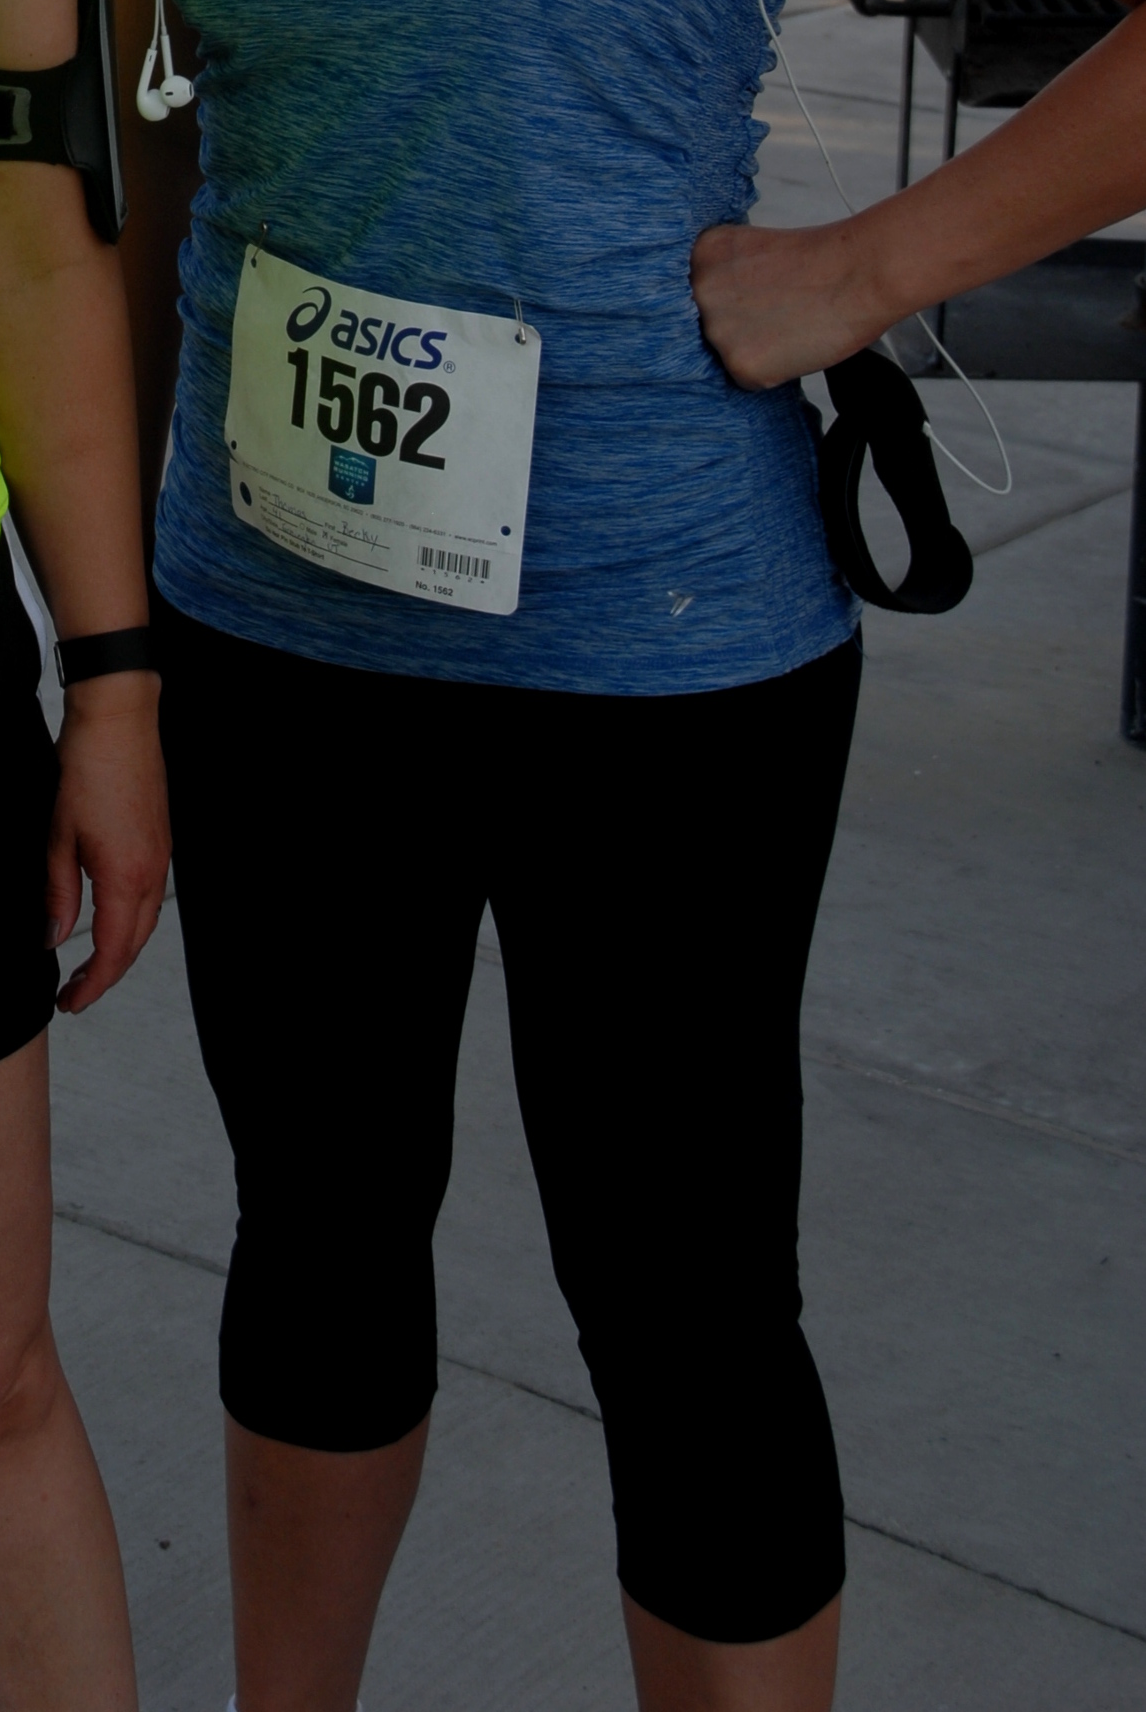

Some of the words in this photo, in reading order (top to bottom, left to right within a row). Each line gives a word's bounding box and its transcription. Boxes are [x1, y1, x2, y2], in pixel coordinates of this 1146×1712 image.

[330, 309, 448, 370] asics
[287, 346, 451, 471] 1562
[415, 580, 431, 592] No.
[433, 585, 454, 597] 1562
